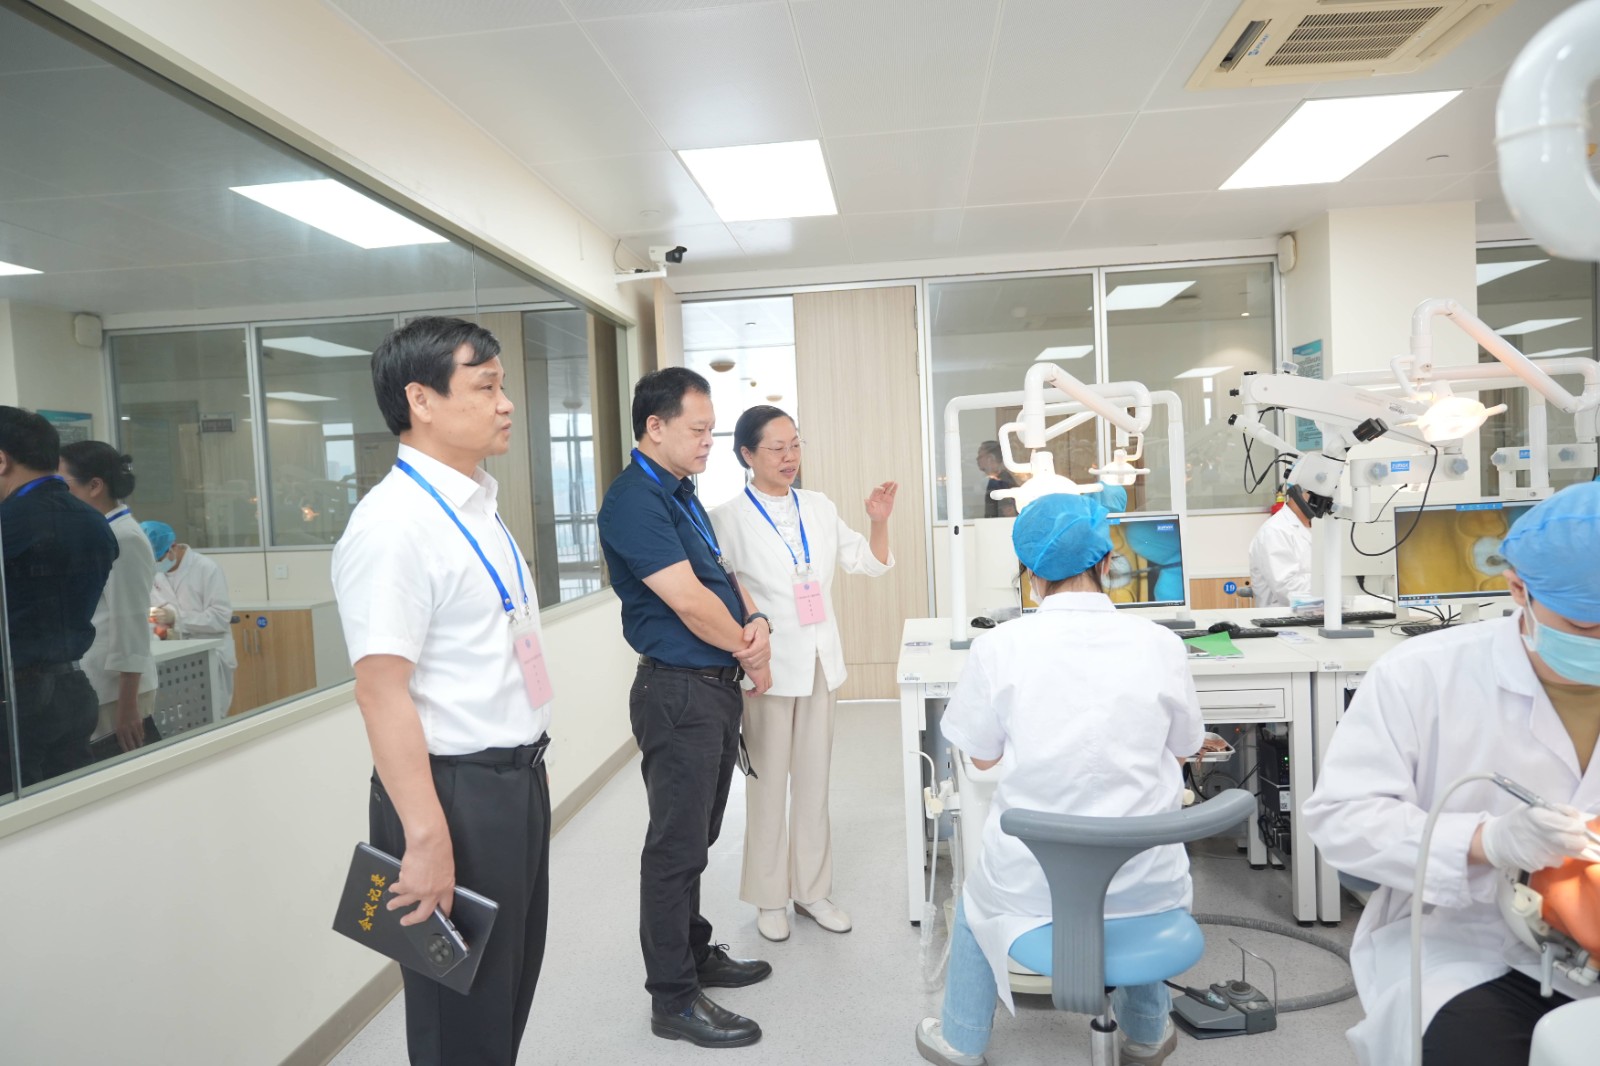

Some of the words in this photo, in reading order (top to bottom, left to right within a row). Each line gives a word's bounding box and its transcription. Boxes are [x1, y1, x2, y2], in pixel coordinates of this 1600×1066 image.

[1225, 583, 1235, 592] 19
[358, 874, 386, 931] 会议记录
